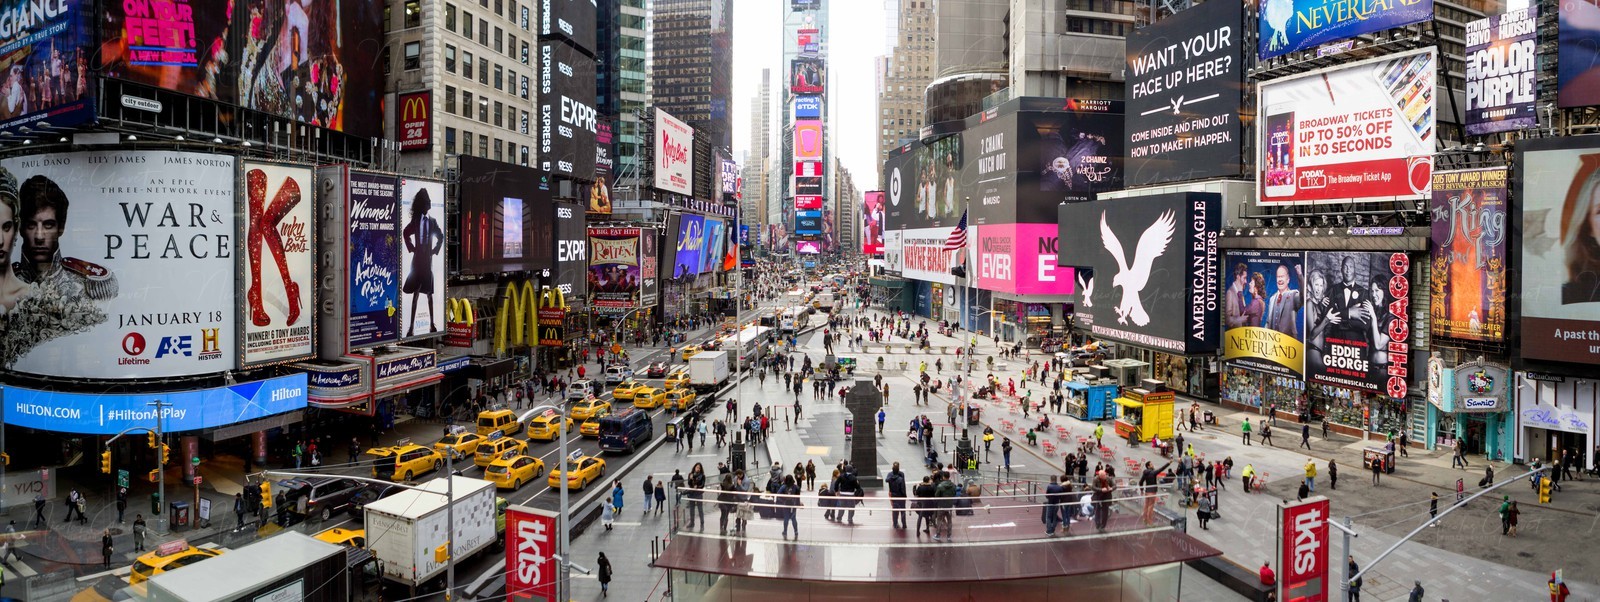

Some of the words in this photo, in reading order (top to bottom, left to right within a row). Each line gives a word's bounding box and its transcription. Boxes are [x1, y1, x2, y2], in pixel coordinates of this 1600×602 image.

[123, 0, 149, 17] ON
[150, 0, 193, 22] YOUR
[1499, 8, 1529, 25] JENNIFER
[22, 37, 28, 46] BY
[35, 29, 48, 39] TRUE
[49, 21, 67, 35] STORY
[125, 16, 196, 48] FEET!
[1466, 28, 1490, 47] ERIVO
[1499, 17, 1536, 40] HUDSON
[1133, 44, 1177, 77] WANT
[1181, 26, 1231, 60] YOUR
[1476, 40, 1535, 80] COLOR
[542, 45, 551, 93] EXPRESS
[1466, 52, 1476, 81] THE
[1133, 76, 1162, 99] FACE
[1165, 70, 1183, 89] UP
[1186, 55, 1232, 84] HERE?
[1466, 71, 1535, 111] PURPLE
[124, 97, 137, 107] city
[137, 99, 160, 110] outdoor
[1482, 111, 1489, 119] ON
[1489, 107, 1517, 118] BROADWAY
[404, 121, 425, 129] OPEN
[1131, 130, 1149, 142] COME
[1150, 125, 1172, 139] INSIDE
[1174, 122, 1190, 134] AND
[1192, 119, 1210, 131] FIND
[1212, 113, 1229, 127] OUT
[1299, 114, 1349, 129] BROADWAY
[1353, 108, 1393, 121] TICKETS
[407, 128, 423, 139] 24
[542, 105, 551, 153] EXPRESS
[1299, 131, 1314, 143] UP
[1317, 129, 1334, 141] TO
[1336, 124, 1363, 139] 50%
[1365, 120, 1393, 135] OFF
[402, 138, 427, 146] HOURS
[1131, 146, 1148, 158] HOW
[1150, 144, 1160, 154] TO
[1161, 139, 1183, 153] MAKE
[1185, 138, 1191, 148] IT
[1194, 131, 1232, 147] HAPPEN.
[1299, 145, 1311, 157] IN
[1314, 143, 1329, 156] 30
[1332, 136, 1393, 154] SECONDS
[21, 159, 41, 169] PAUL
[44, 157, 71, 166] DANO
[88, 156, 109, 164] LILY
[113, 156, 146, 164] JAMES
[163, 156, 193, 165] JAMES
[196, 159, 231, 168] NORTON
[1086, 156, 1107, 164] CHAINZ
[171, 178, 195, 186] EPIC
[1302, 170, 1325, 178] TODAY
[1306, 177, 1319, 187] TIX
[1328, 175, 1337, 184] The
[1338, 173, 1363, 184] Broadway
[1363, 172, 1380, 181] Ticket
[1380, 172, 1392, 181] App
[1433, 174, 1444, 183] 2015
[1445, 173, 1459, 183] TONY
[1460, 171, 1480, 182] AWARD
[1481, 170, 1506, 181] WINNER!
[1481, 180, 1505, 188] MUSICAL
[101, 187, 198, 195] THREE-NETWORK
[986, 196, 1000, 205] MUSIC
[119, 202, 207, 228] WAR
[210, 209, 224, 224] &
[350, 198, 395, 221] Winner!
[557, 207, 572, 218] RESS
[1432, 205, 1449, 222] The
[1193, 201, 1206, 254] EAGLE
[1443, 193, 1506, 247] King
[104, 233, 231, 260] PEACE
[322, 177, 335, 316] PALACE
[904, 245, 926, 270] WAYNE
[927, 246, 952, 274] BRADY
[982, 253, 1011, 280] EVER
[1207, 231, 1217, 311] OUTFITTERS
[1193, 255, 1206, 341] AMERICAN
[118, 311, 202, 330] JANUARY
[209, 310, 223, 323] 18
[1387, 252, 1410, 399] CHICAGO
[247, 331, 270, 342] WINNER!
[275, 328, 289, 338] TONY
[290, 326, 310, 337] AWARDS
[287, 335, 310, 343] MUSICAL
[1245, 328, 1281, 343] FINDING
[1554, 328, 1562, 338] A
[1563, 330, 1586, 341] past
[155, 335, 193, 359] A&E
[198, 353, 223, 361] HISTORY
[1230, 335, 1297, 359] NEVERLAND
[1331, 344, 1360, 359] EDDIE
[118, 357, 150, 366] Lifetime
[1323, 355, 1369, 372] GEORGE
[1276, 376, 1305, 390] GRAND
[1314, 373, 1378, 390] CHICAGOTHEMUSICAL.COM
[271, 387, 302, 402] Hilton
[1323, 385, 1350, 399] SLAM
[16, 402, 81, 419] HILTON.COM
[108, 408, 187, 422] #HiltonAtPlay
[1466, 399, 1495, 407] Sanrio
[1523, 408, 1560, 425] Blue
[1561, 412, 1588, 428] Fin
[1294, 508, 1322, 576] tkts
[518, 519, 548, 586] tkts
